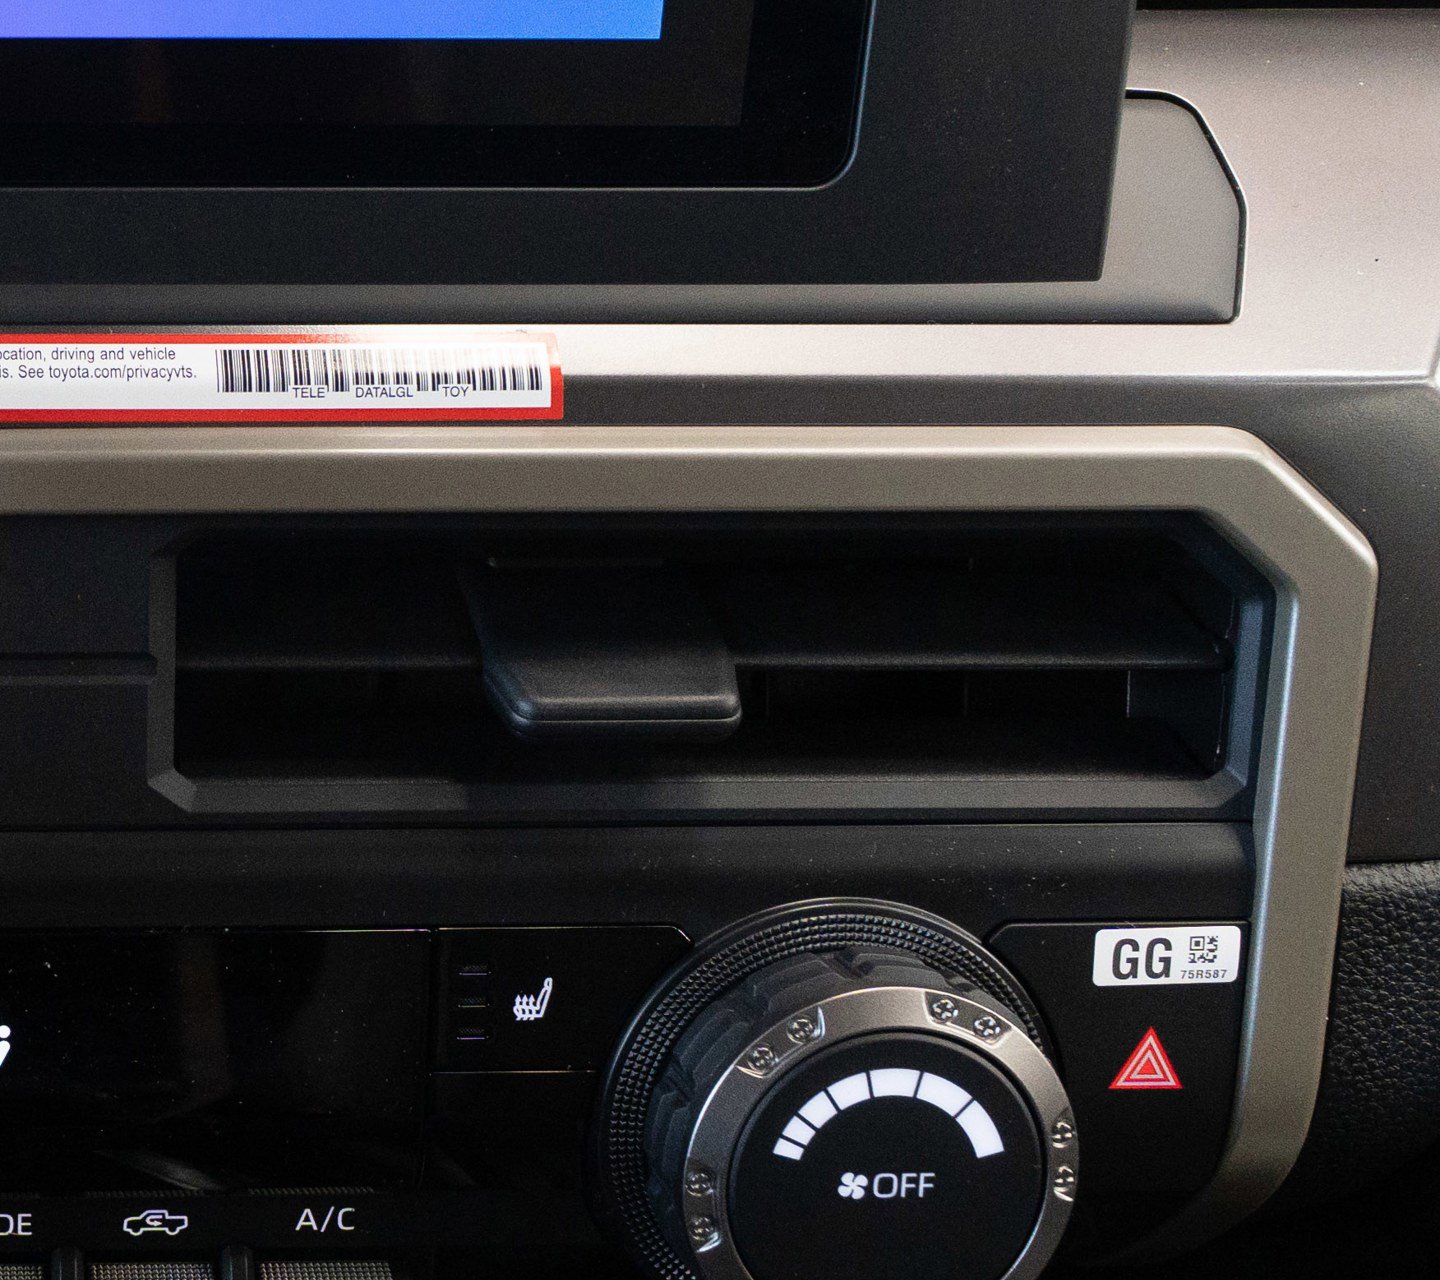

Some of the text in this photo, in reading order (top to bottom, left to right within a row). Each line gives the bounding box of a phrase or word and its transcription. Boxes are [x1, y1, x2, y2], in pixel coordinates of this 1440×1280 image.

[51, 347, 95, 363] driving
[100, 347, 124, 360] and
[130, 347, 176, 360] vehicle
[18, 365, 44, 379] See
[292, 385, 470, 398] TELE DATALGL TOY
[1112, 937, 1173, 980] GG
[1180, 968, 1228, 980] 75R587
[872, 1172, 936, 1199] OFF
[296, 1206, 356, 1233] A/C
